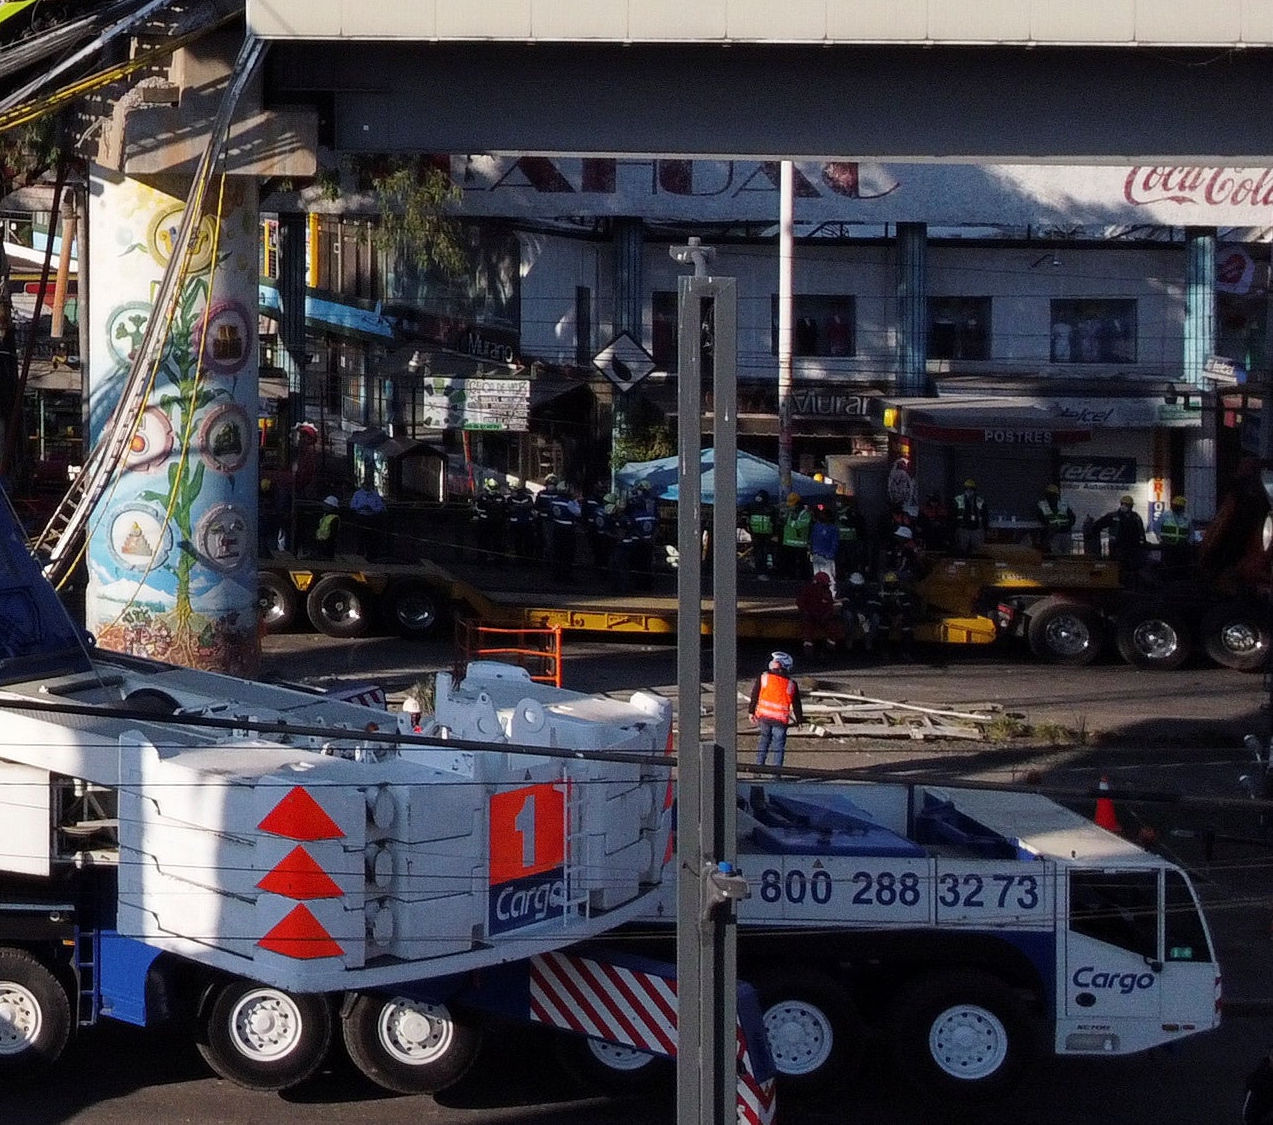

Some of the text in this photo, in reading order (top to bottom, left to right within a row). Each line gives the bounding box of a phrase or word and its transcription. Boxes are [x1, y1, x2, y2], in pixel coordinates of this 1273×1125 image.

[985, 428, 1053, 443] POSTRES
[515, 784, 536, 868] 1
[496, 881, 566, 922] Cargo
[760, 868, 833, 905] 800
[851, 871, 921, 906] 288
[1072, 966, 1156, 994] Cargo
